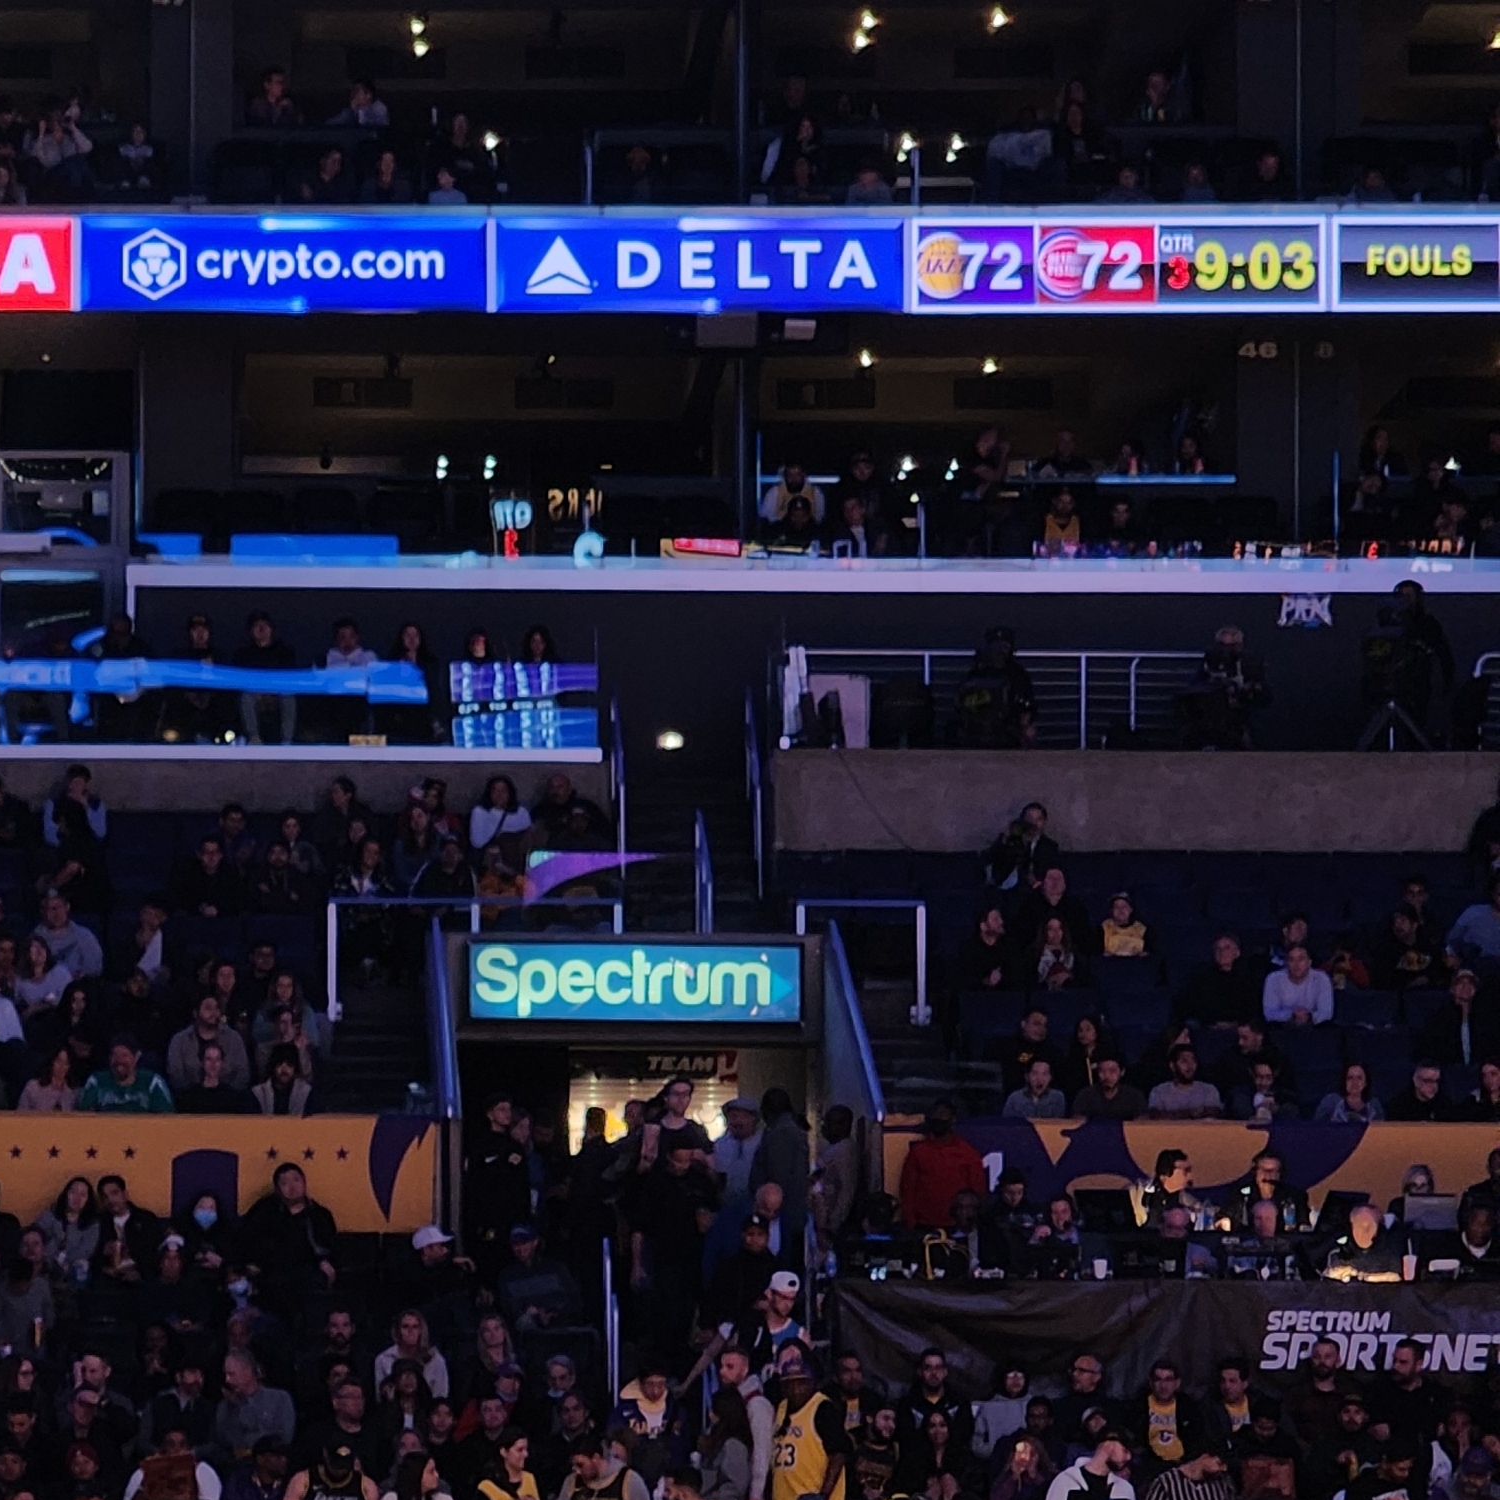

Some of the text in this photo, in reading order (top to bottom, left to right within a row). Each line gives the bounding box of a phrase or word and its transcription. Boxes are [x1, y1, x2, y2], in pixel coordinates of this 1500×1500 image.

[196, 243, 445, 286] crypto.com
[616, 239, 877, 289] DELTA
[957, 242, 1023, 291] 72
[1076, 241, 1144, 291] 72
[1160, 234, 1194, 253] QTR
[1167, 241, 1316, 291] 3 9:03
[1365, 244, 1472, 277] FOULS
[476, 947, 772, 1018] Spectrum
[647, 1056, 714, 1071] TEAM
[1266, 1311, 1391, 1332] SPECTRUM
